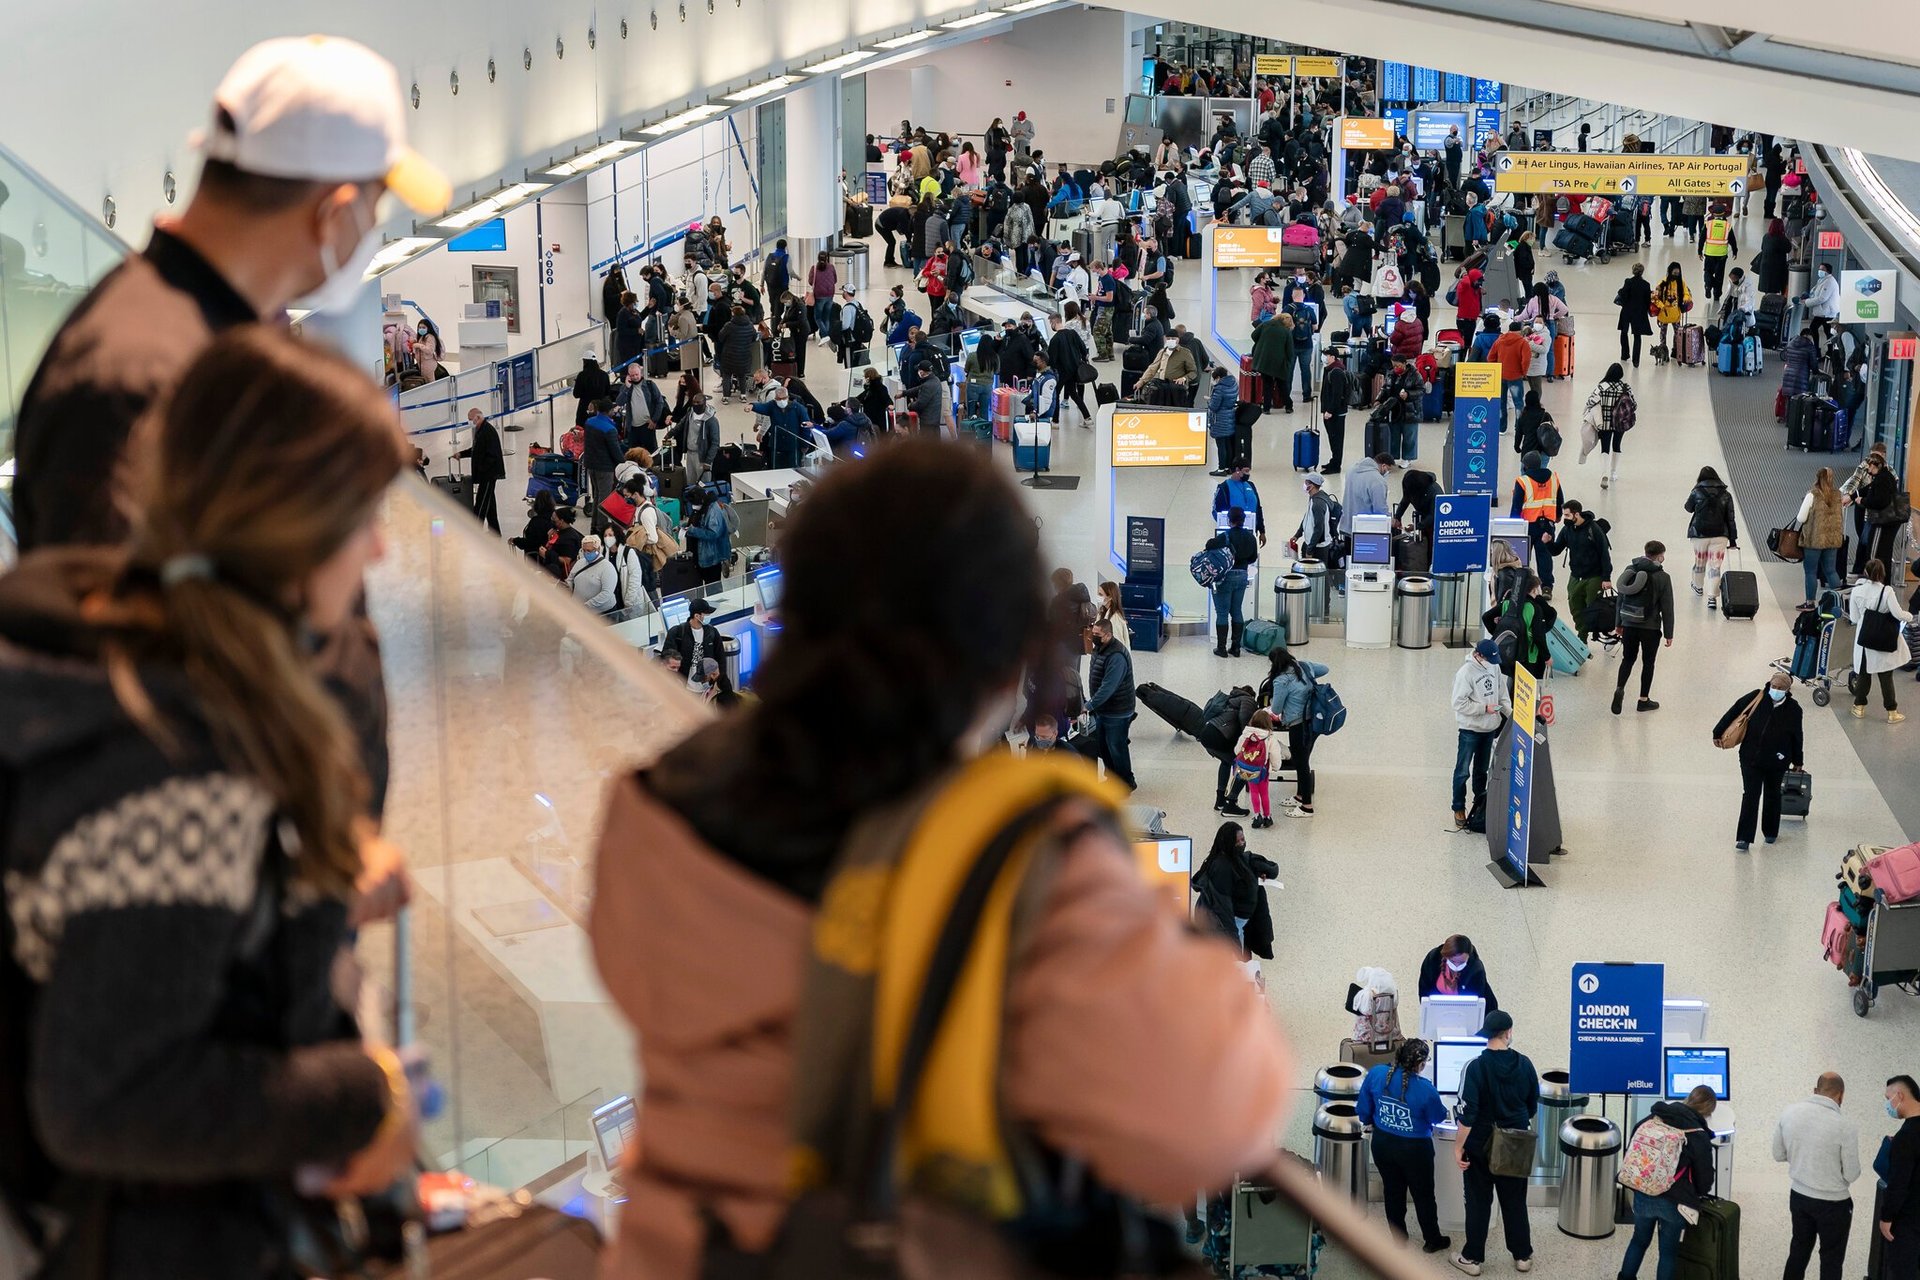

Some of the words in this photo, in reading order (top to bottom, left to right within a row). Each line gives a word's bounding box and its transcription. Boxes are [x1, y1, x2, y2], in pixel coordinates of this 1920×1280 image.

[1531, 160, 1547, 168] Aer
[1549, 160, 1581, 170] Lingus,
[1583, 161, 1626, 169] Hawaiian
[1628, 161, 1665, 170] Airlines,
[1668, 162, 1685, 170] TAP
[1687, 162, 1701, 170] Air
[1703, 162, 1742, 172] Portugal
[1553, 179, 1571, 188] TSA
[1574, 179, 1589, 188] Pre
[1668, 179, 1681, 187] All
[1684, 179, 1711, 188] Gates
[1821, 233, 1840, 247] EXIT
[1893, 340, 1915, 357] EXIT
[1196, 416, 1201, 426] 1
[1439, 520, 1470, 528] LONDON
[1438, 528, 1474, 536] CHECK-IN
[1171, 848, 1178, 864] 1
[1578, 1004, 1630, 1016] LONDON
[1578, 1018, 1637, 1030] CHECK-IN
[1627, 1080, 1654, 1089] jetBlue
